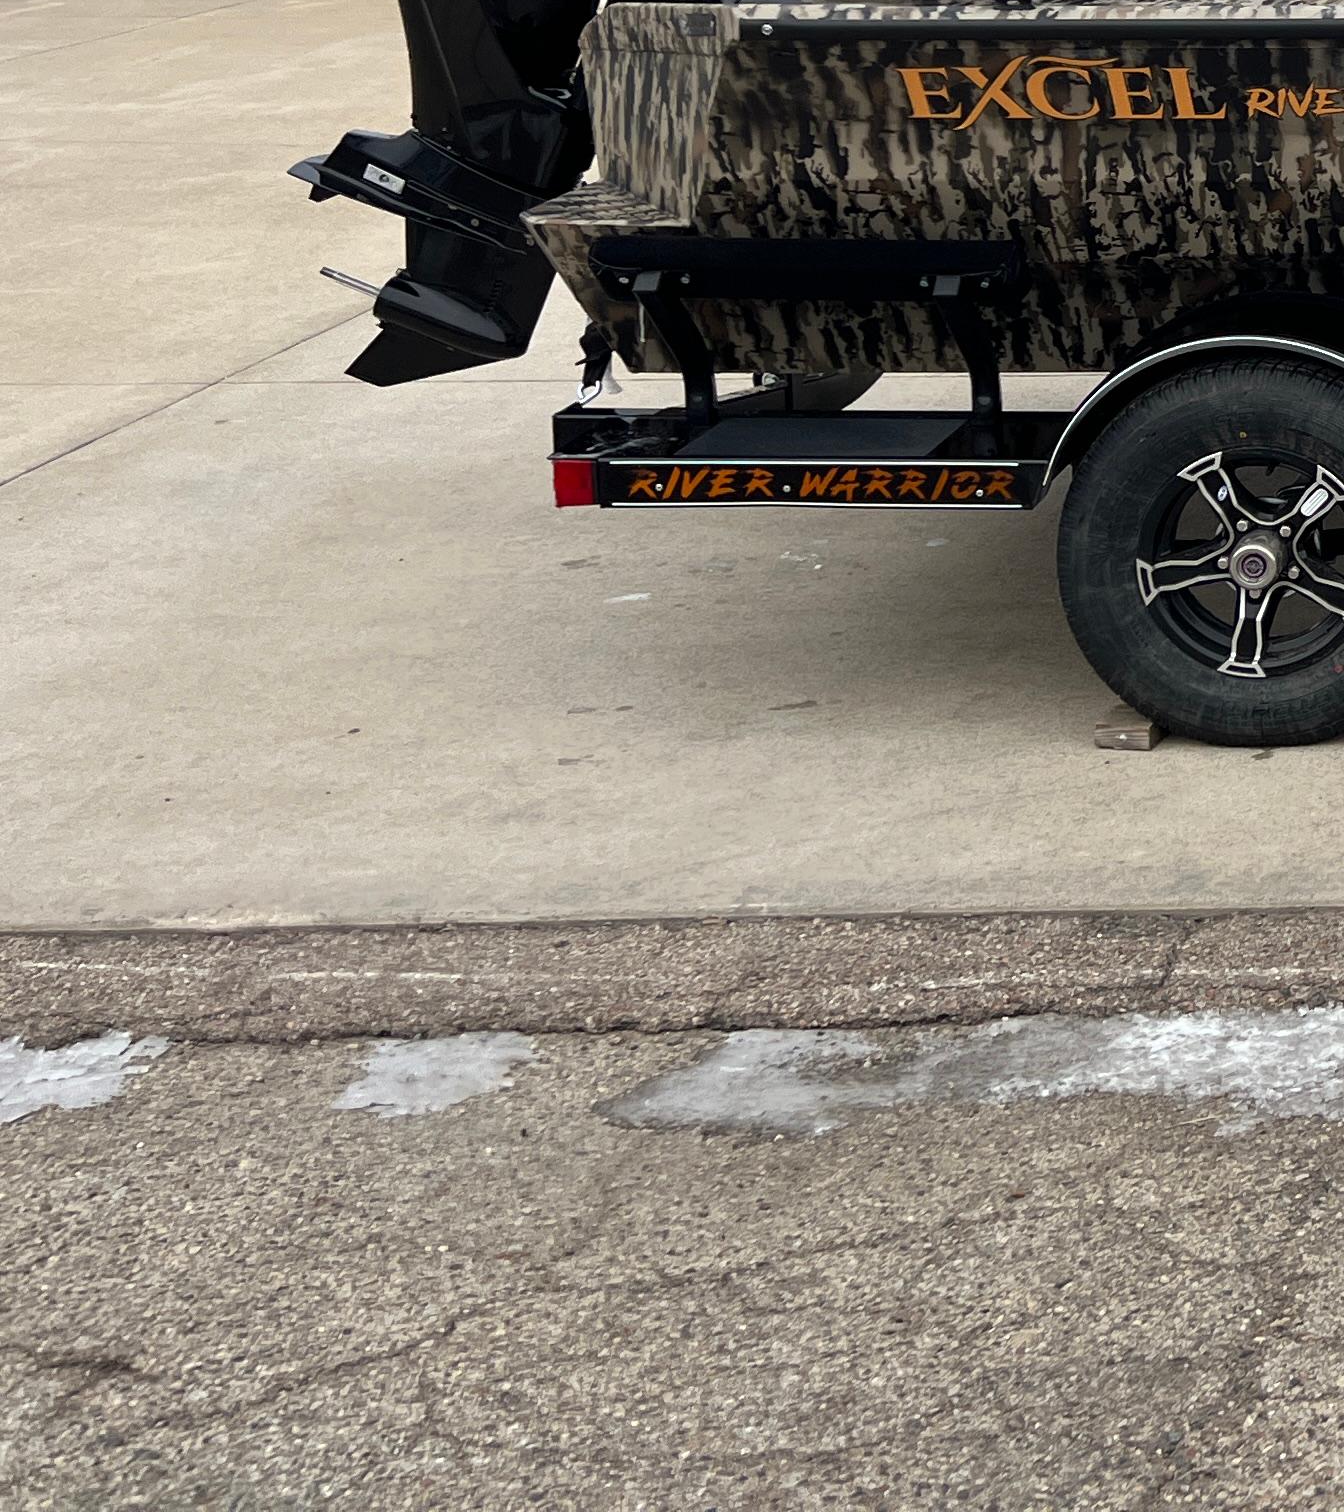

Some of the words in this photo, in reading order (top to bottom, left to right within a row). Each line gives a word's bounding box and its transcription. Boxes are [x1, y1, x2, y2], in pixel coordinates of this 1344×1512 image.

[897, 54, 1228, 130] EXCEL
[627, 465, 775, 500] RIVER
[798, 465, 1018, 501] WARRIOR
